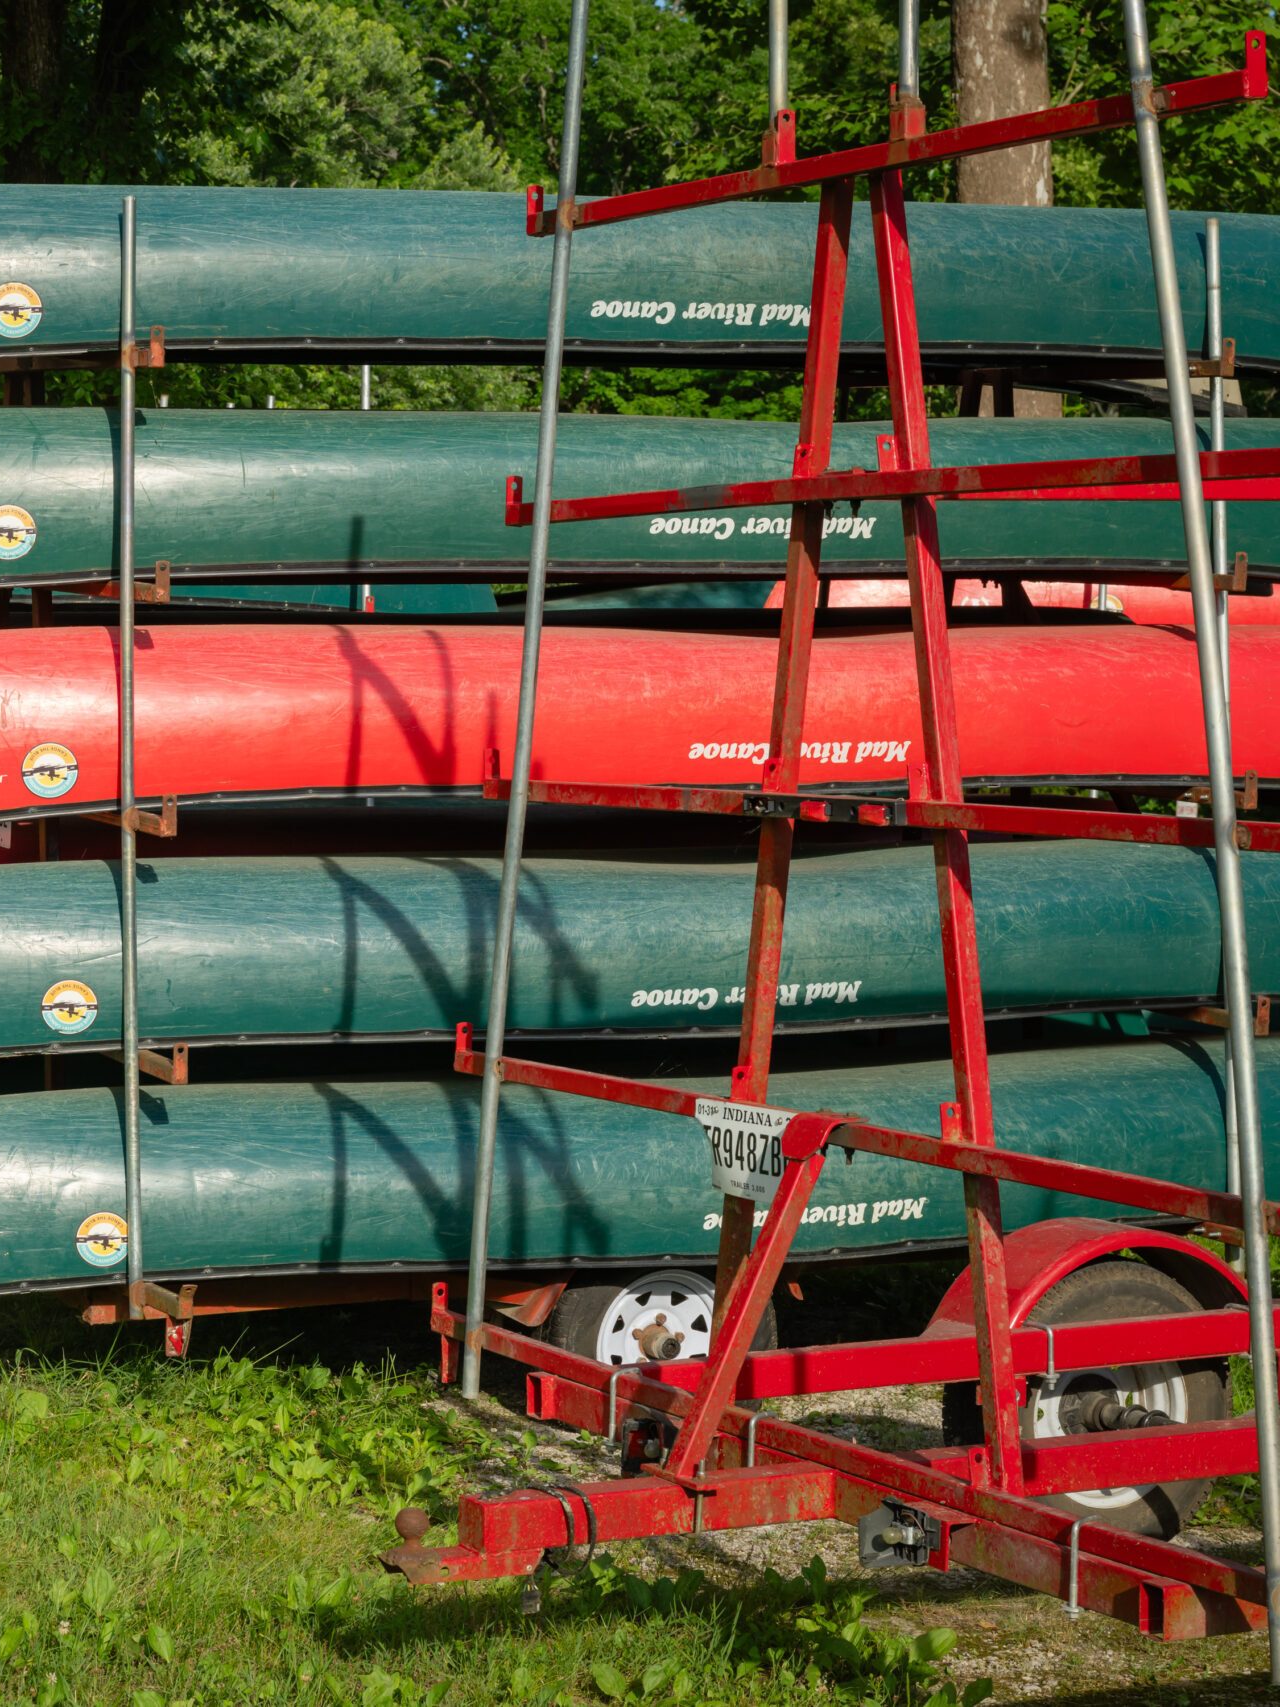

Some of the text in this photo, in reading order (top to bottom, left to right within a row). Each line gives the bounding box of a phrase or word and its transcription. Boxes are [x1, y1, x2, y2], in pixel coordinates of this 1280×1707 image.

[590, 300, 811, 327] Mad River Canoe
[649, 517, 877, 540] Mad iver Canoe
[688, 740, 911, 765] Mad Riv Canoe
[631, 987, 719, 1010] Canoe
[805, 981, 862, 1005] Mad
[723, 1107, 772, 1127] INDIANA
[703, 1124, 791, 1177] R948ZB
[871, 1197, 928, 1223] Mad
